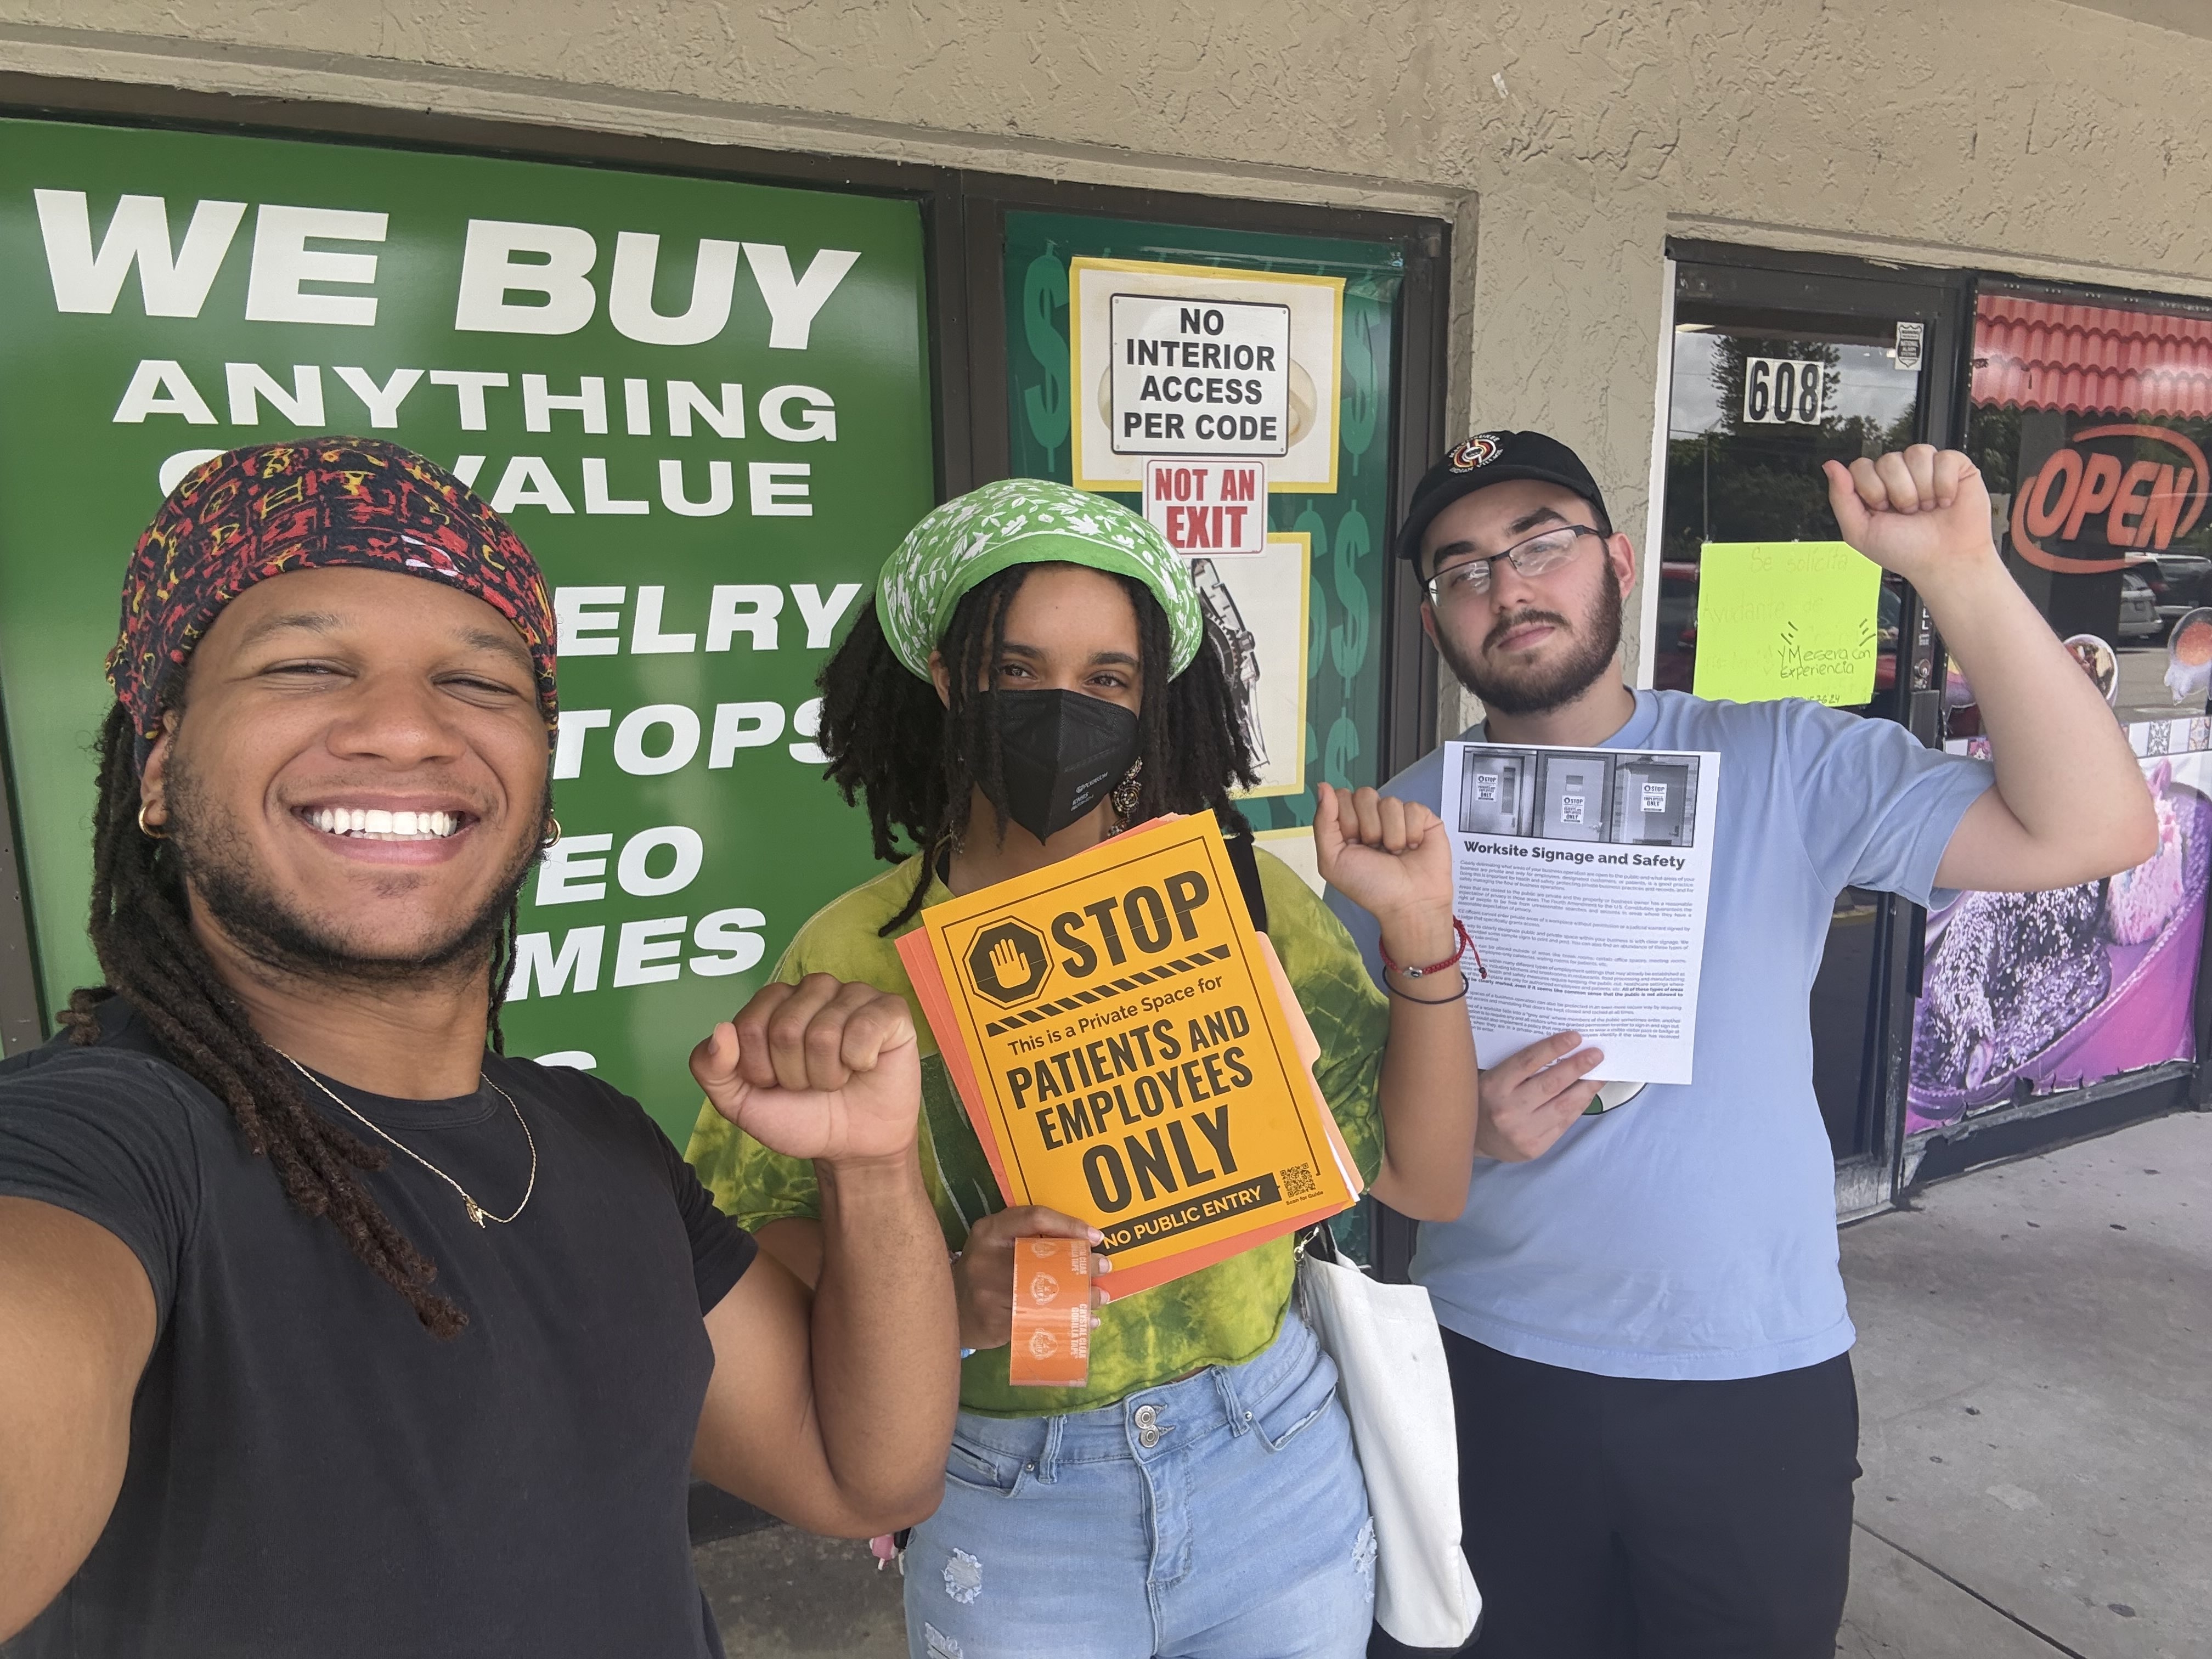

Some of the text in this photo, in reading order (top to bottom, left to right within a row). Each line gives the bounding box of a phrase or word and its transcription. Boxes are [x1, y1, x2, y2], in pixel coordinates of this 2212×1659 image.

[33, 189, 862, 349] WE BUY
[1180, 308, 1224, 336] NO
[1126, 338, 1276, 371] INTERIOR
[112, 359, 838, 442] ANYTHING
[1140, 375, 1262, 405] ACCESS
[1748, 360, 1819, 421] 608
[1124, 413, 1277, 441] PER CODE
[1155, 468, 1255, 501] NOT AN
[2027, 448, 2194, 550] OPEN
[1166, 506, 1248, 548] EXIT
[1751, 547, 1773, 573] Se
[554, 583, 863, 657] ELRY
[1780, 661, 1854, 680] Experiencia
[1851, 649, 1871, 659] con
[552, 696, 832, 780] TOPS
[1463, 840, 1686, 871] Worksite Signage and Safety
[504, 907, 766, 1002] MES
[1051, 870, 1210, 979] STOP
[1008, 975, 1223, 1056] This is a Private Space for
[1006, 1005, 1250, 1110] PATIENTS AND
[1035, 1046, 1253, 1151] EMPLOYEES
[1082, 1104, 1238, 1214] ONLY
[1103, 1229, 1131, 1250] NO
[1133, 1206, 1201, 1239] PUBLIC
[1204, 1185, 1262, 1217] ENTRY
[1071, 1307, 1079, 1338] GORILLA
[1079, 1304, 1087, 1336] CRYSTAL
